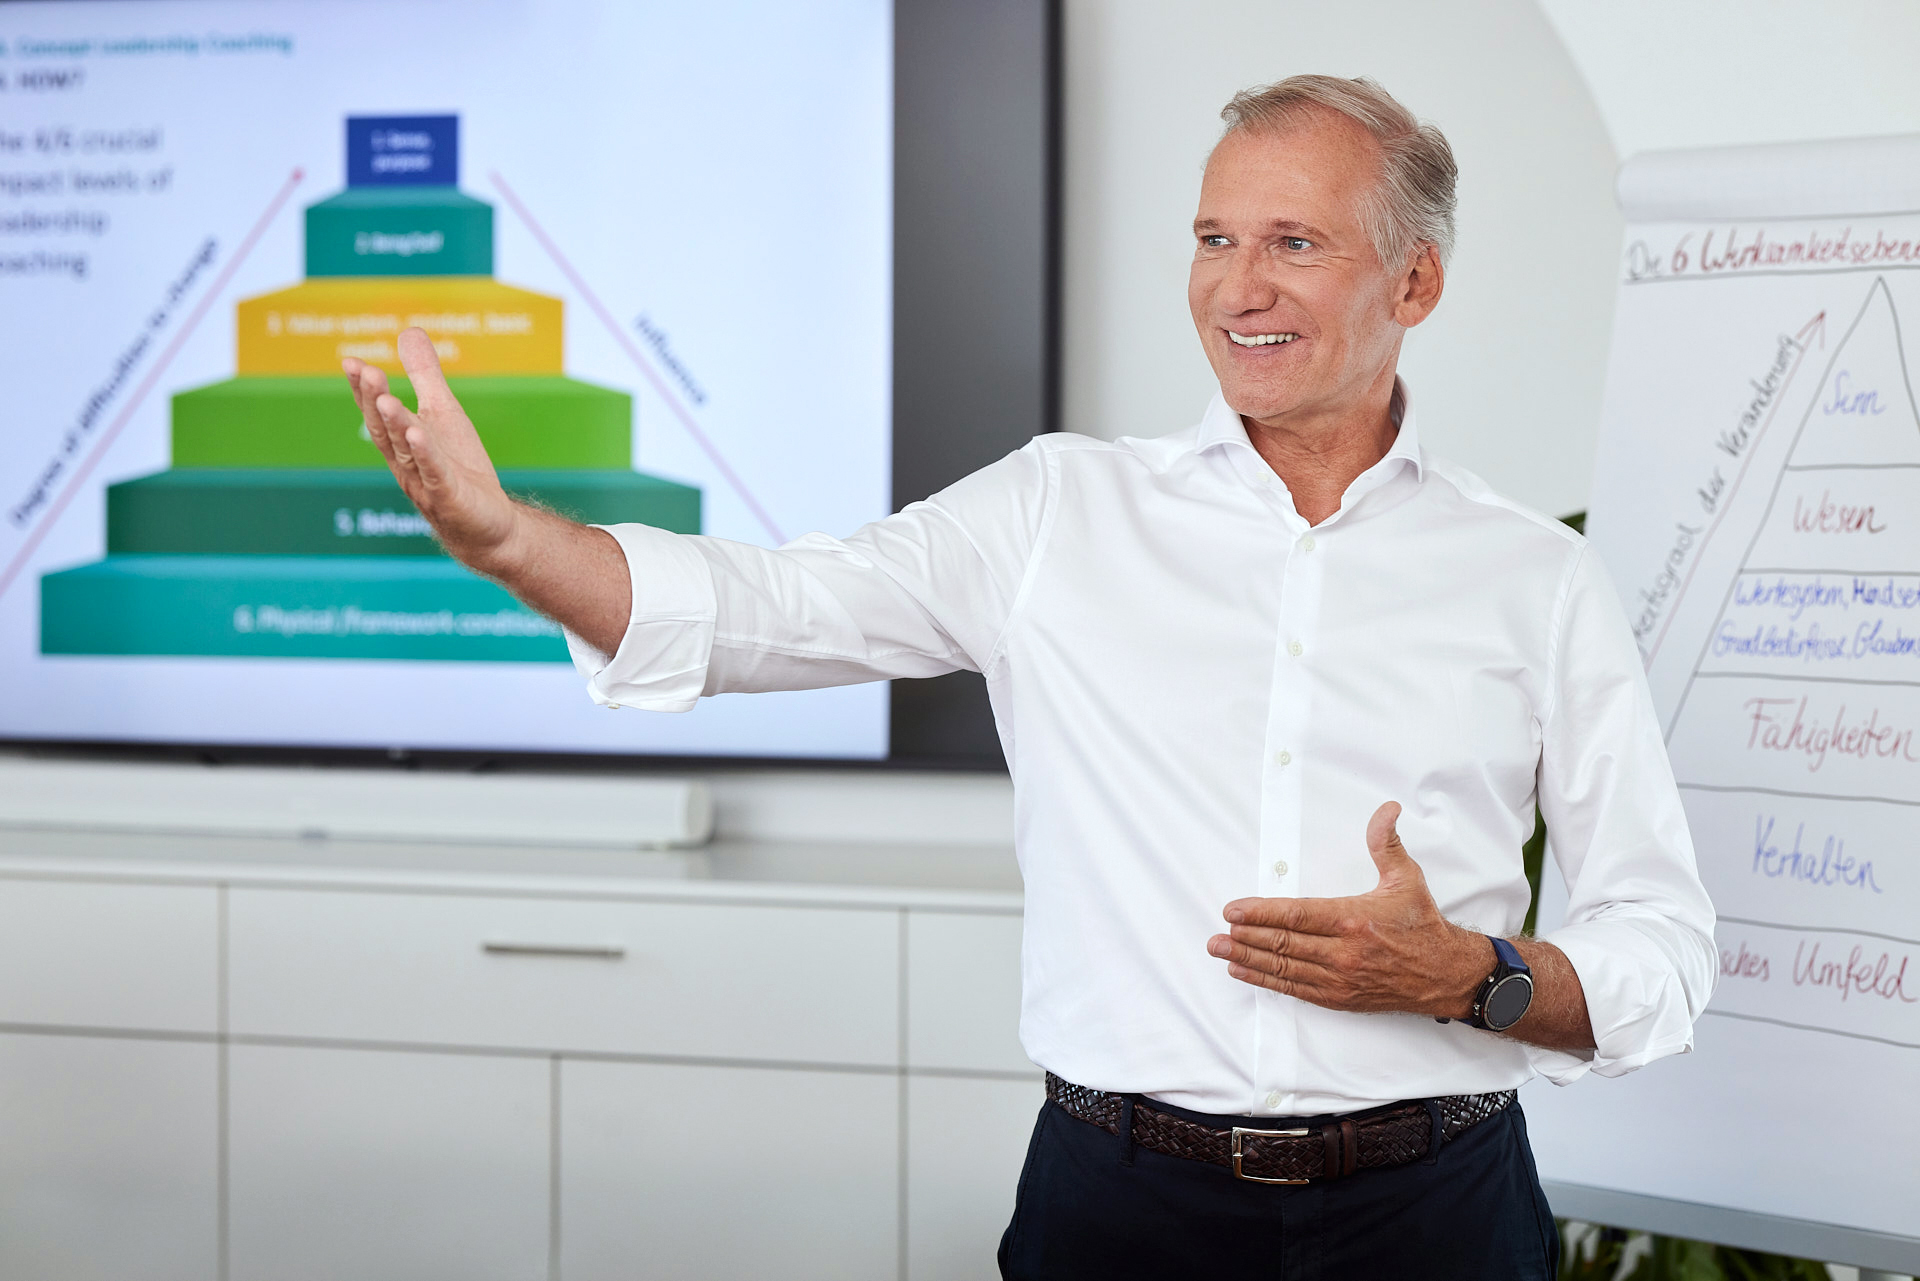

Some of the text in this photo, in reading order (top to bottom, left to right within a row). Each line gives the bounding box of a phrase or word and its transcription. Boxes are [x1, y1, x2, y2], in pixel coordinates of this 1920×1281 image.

[15, 37, 93, 58] Concept
[99, 35, 201, 58] Leadership
[206, 32, 294, 57] Coaching
[16, 68, 85, 92] HOW?
[81, 126, 162, 152] crucial
[71, 166, 140, 193] levels
[147, 164, 174, 192] of
[1627, 240, 1661, 279] Die
[1671, 231, 1695, 274] 6
[11, 456, 67, 526] Degree
[78, 332, 153, 433] difficulties
[147, 305, 172, 332] to
[166, 235, 220, 308] change
[633, 313, 708, 407] Influence
[1823, 369, 1887, 415] Sinn
[1697, 466, 1727, 515] der
[1793, 487, 1887, 533] Wesen
[259, 606, 334, 635] Physical
[1752, 814, 1883, 893] Verhalten
[1791, 939, 1919, 1002] Umfeld
